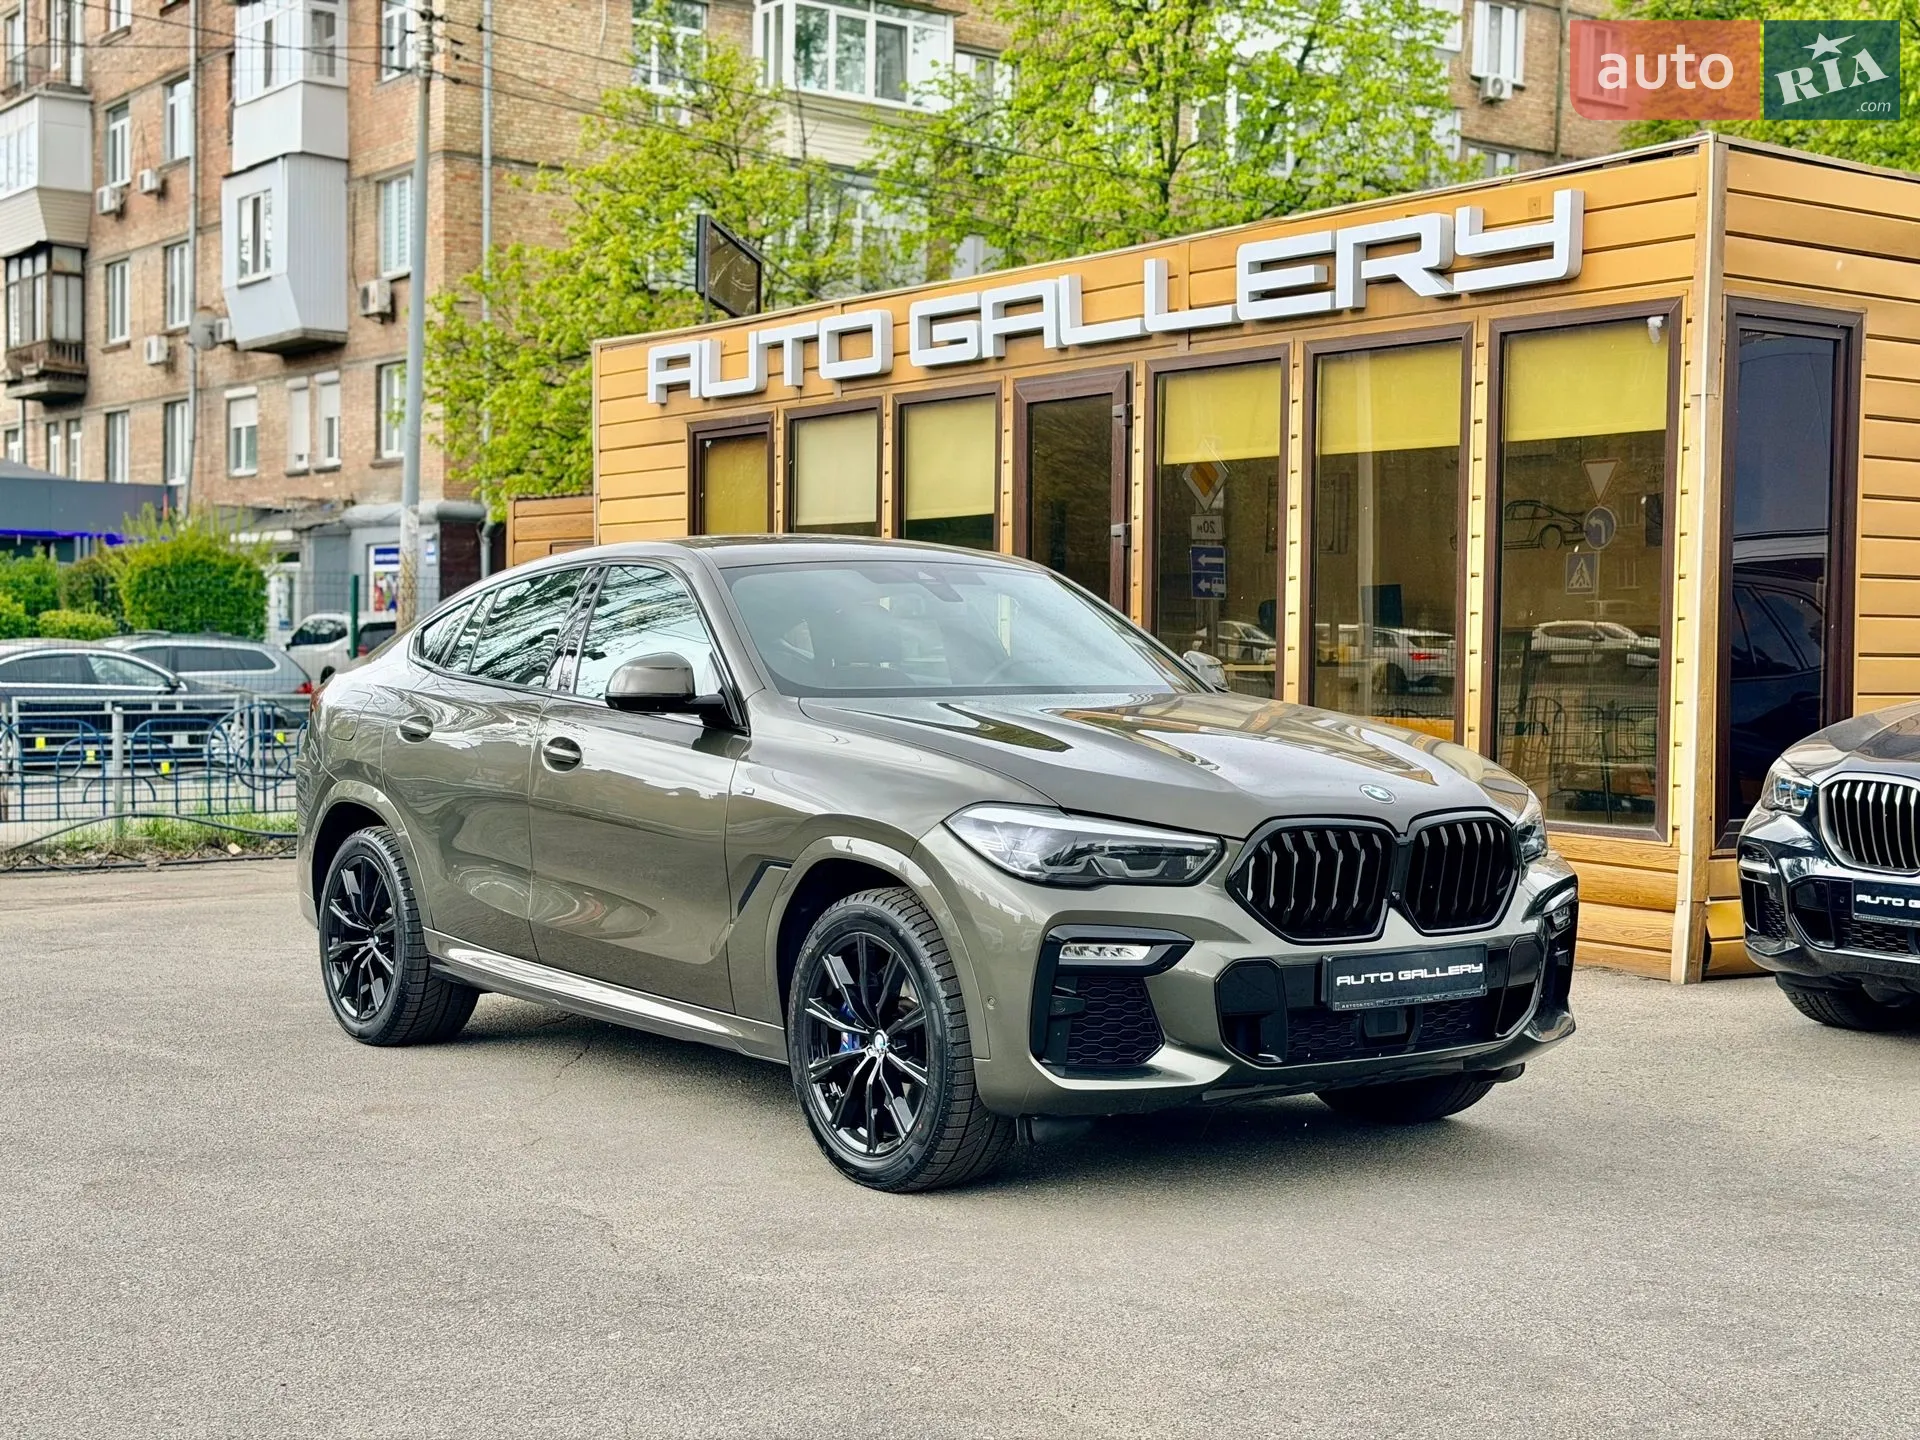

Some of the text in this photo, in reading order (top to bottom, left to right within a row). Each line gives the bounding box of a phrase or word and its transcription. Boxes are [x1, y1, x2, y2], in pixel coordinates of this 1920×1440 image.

[647, 189, 1585, 405] AUTO GALLERY
[1856, 894, 1905, 907] AUTO
[1336, 962, 1484, 987] AUTO GALLERY
